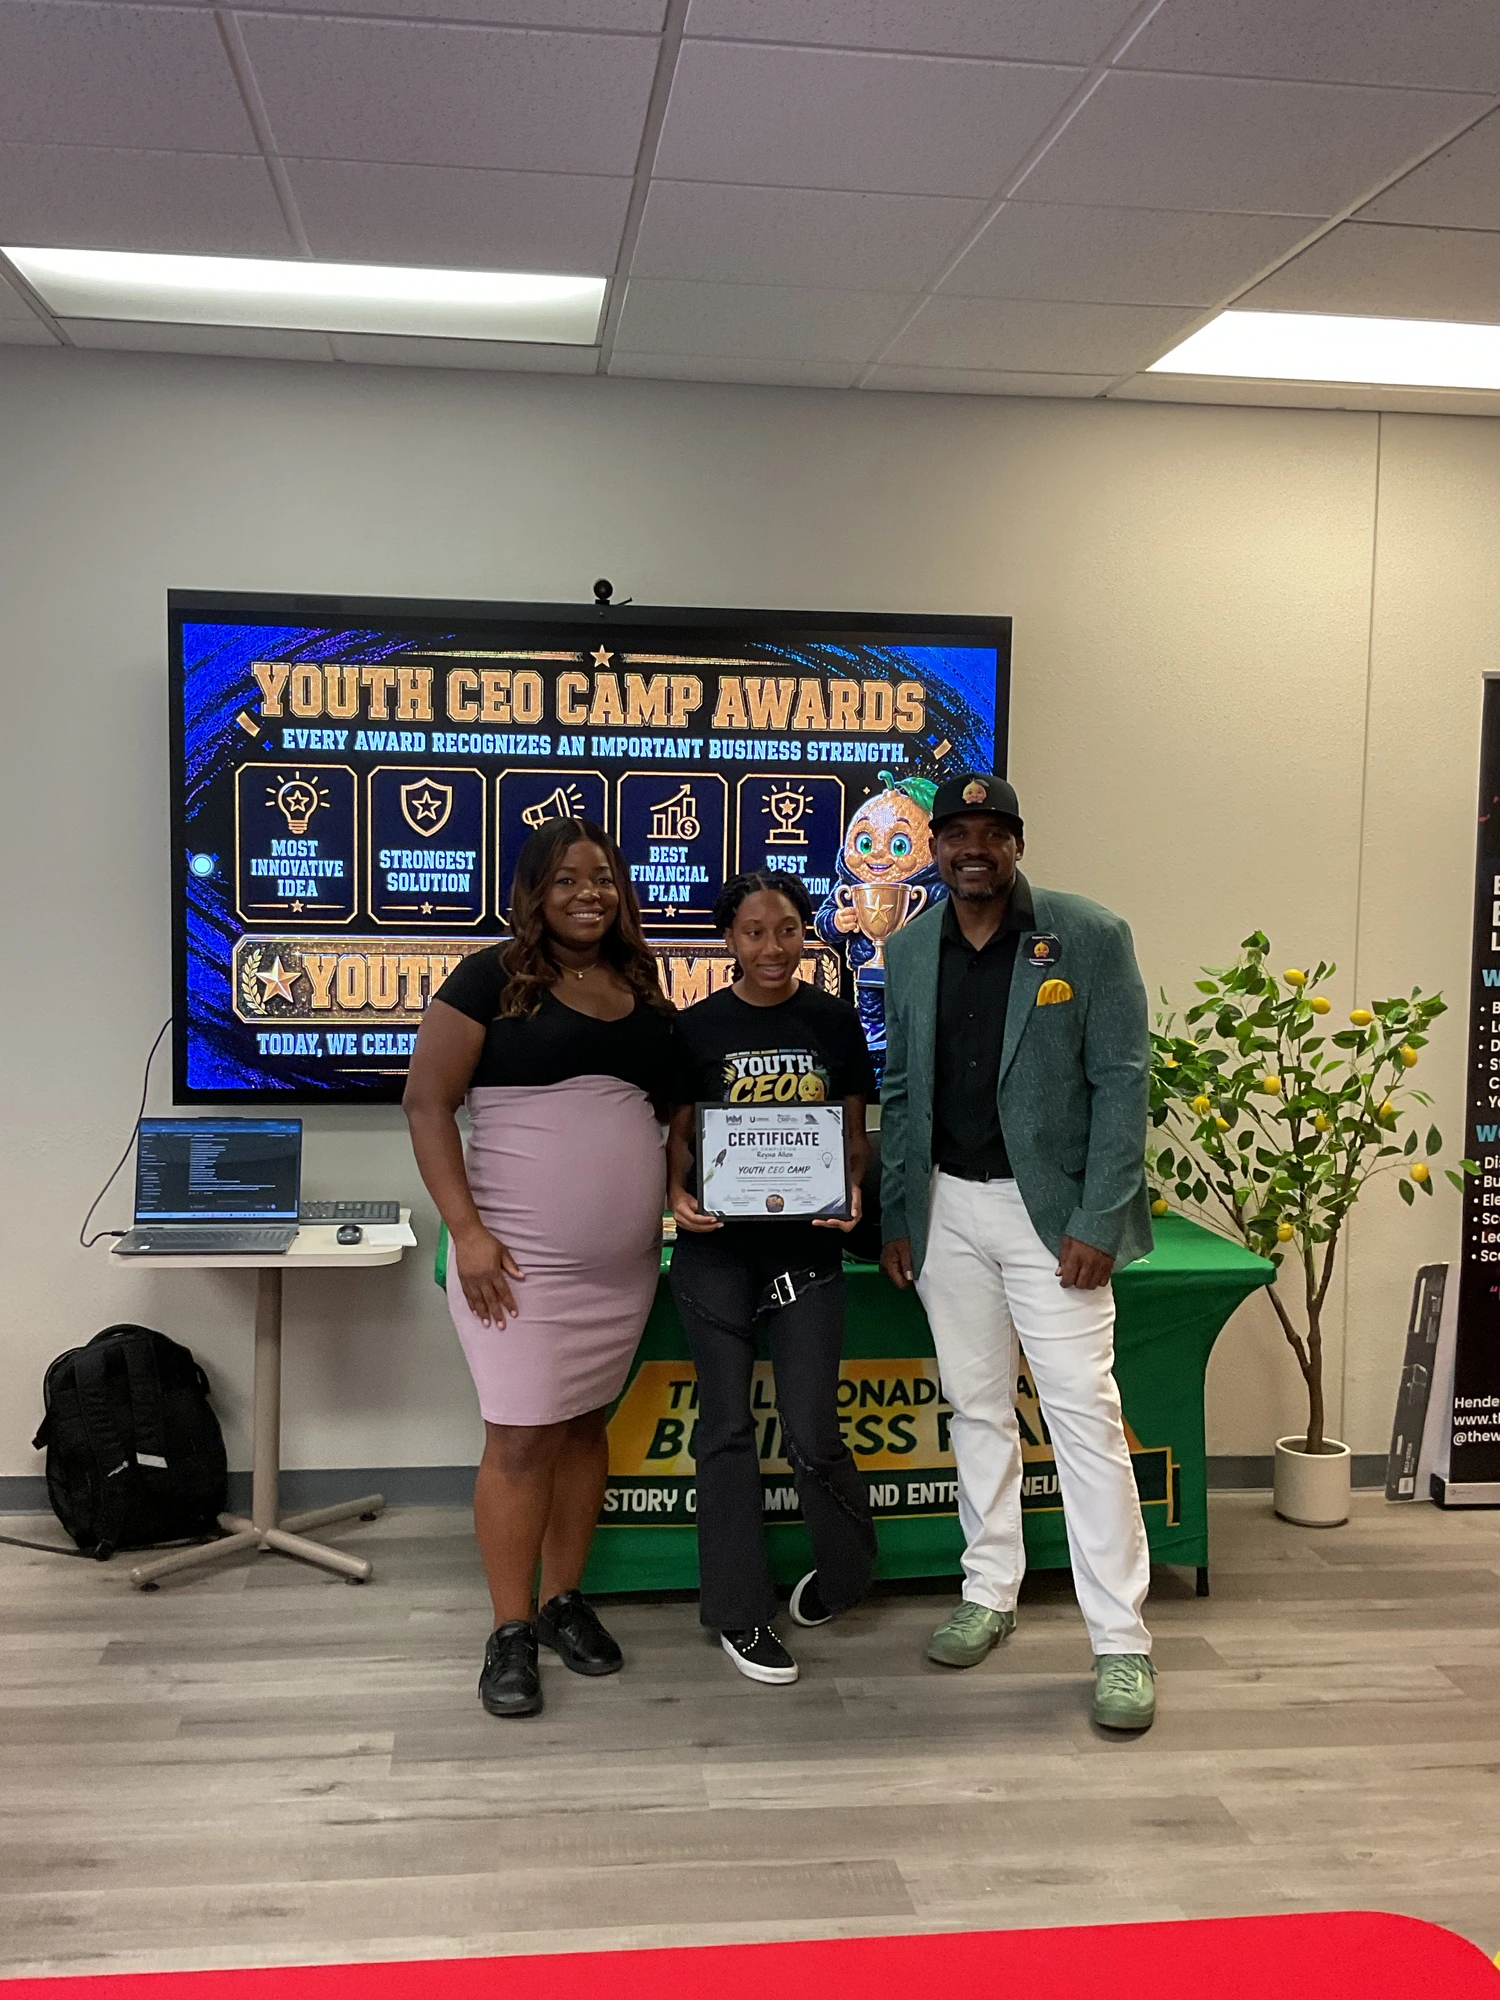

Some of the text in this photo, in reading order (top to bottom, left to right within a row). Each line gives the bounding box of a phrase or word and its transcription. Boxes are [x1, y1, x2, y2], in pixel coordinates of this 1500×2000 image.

[251, 661, 926, 733] YOUTH CEO CAMP AWARDS
[282, 728, 909, 763] EVERY AWARD RECOGNIZES AN IMPORTANT BUSINESS STRENGTH.
[271, 839, 318, 857] MOST
[650, 846, 688, 863] BEST
[251, 859, 344, 877] INNOVATIVE
[380, 850, 476, 870] STRONGEST
[766, 855, 807, 874] BEST
[387, 873, 470, 892] SOLUTION
[630, 865, 708, 883] FINANCIAL
[277, 879, 318, 896] IDEA
[649, 884, 690, 902] PLAN
[257, 1033, 322, 1057] TODAY,
[327, 1034, 357, 1054] WE
[732, 1054, 814, 1078] YOUTH
[729, 1073, 799, 1103] CEO
[728, 1132, 820, 1146] CERTIFICATE
[738, 1166, 765, 1174] YOUTH
[604, 1488, 678, 1512] STORY
